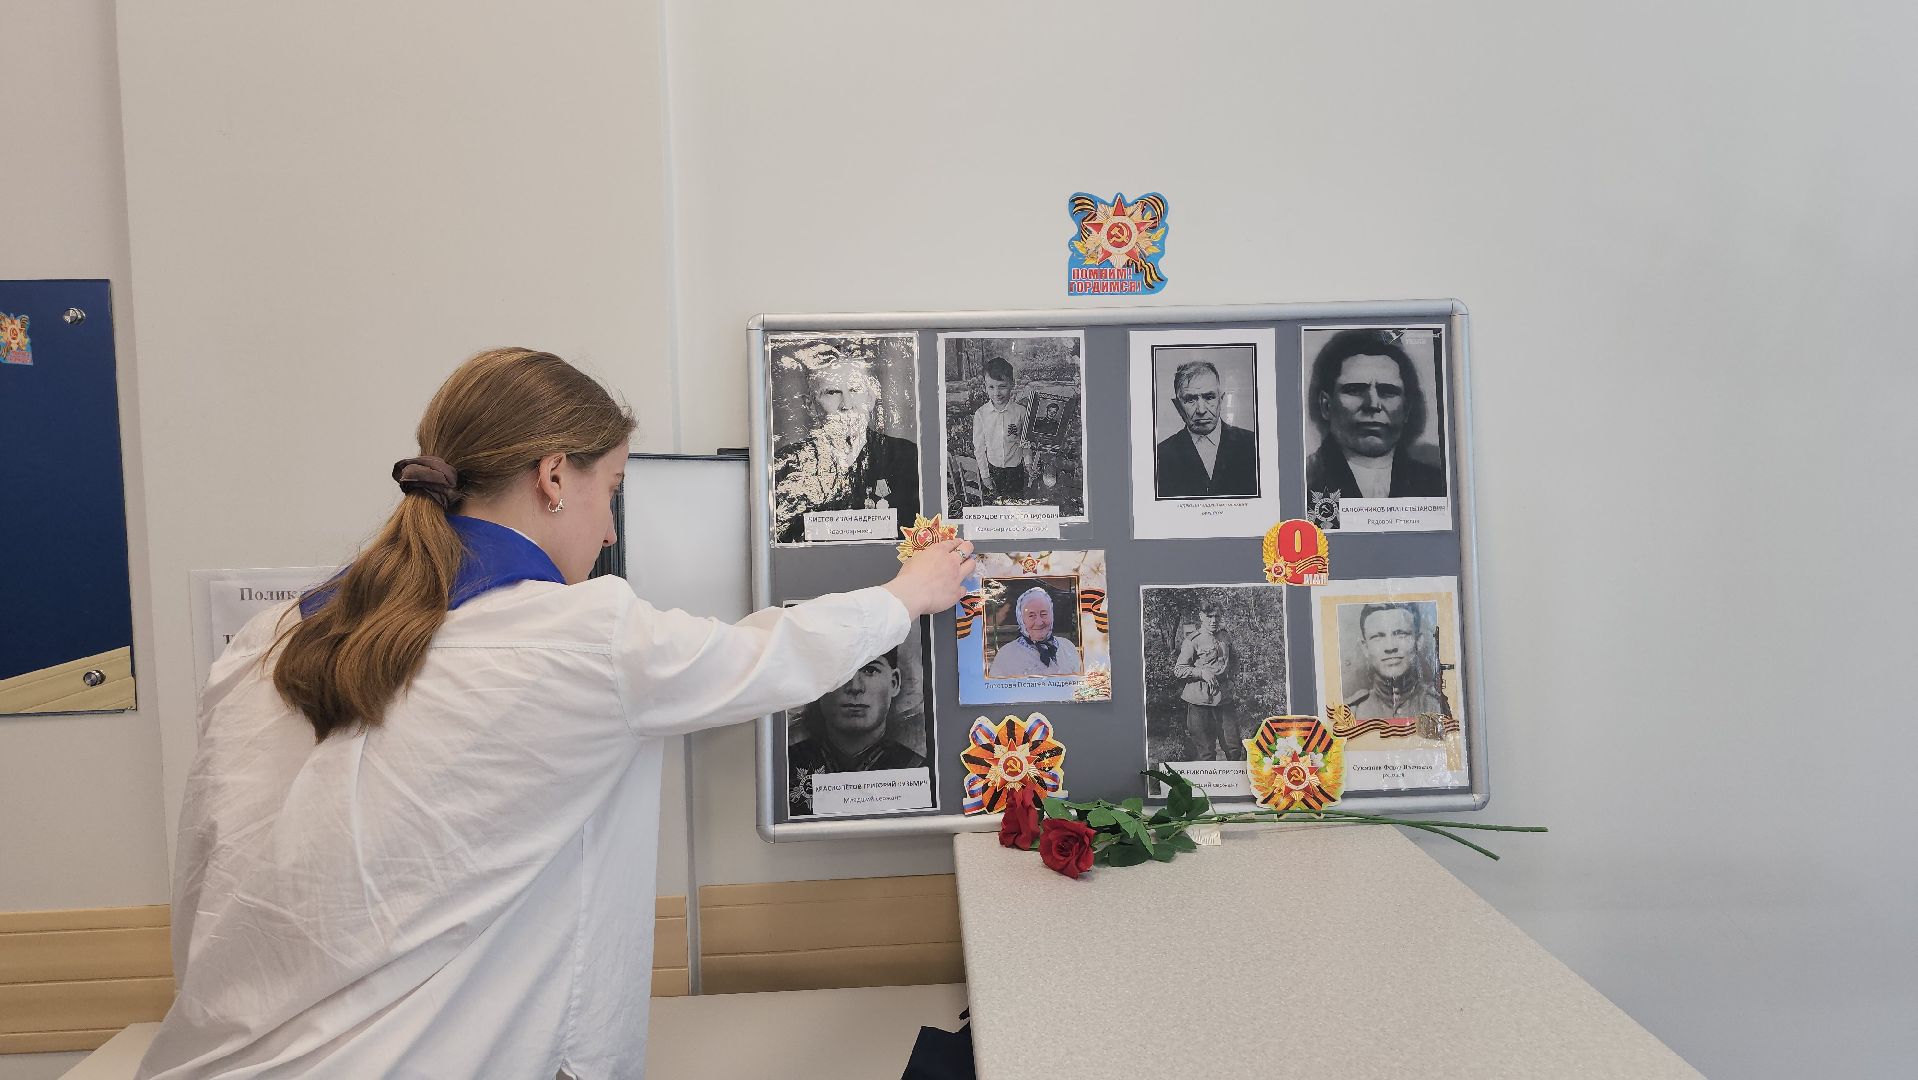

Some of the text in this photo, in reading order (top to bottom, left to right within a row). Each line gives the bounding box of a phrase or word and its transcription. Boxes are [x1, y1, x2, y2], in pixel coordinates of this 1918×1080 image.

[1072, 268, 1132, 280] ПОМНИМ!
[1069, 281, 1141, 293] ГОРДИМСЯ!
[1277, 519, 1318, 584] 9
[240, 587, 304, 600] Полик
